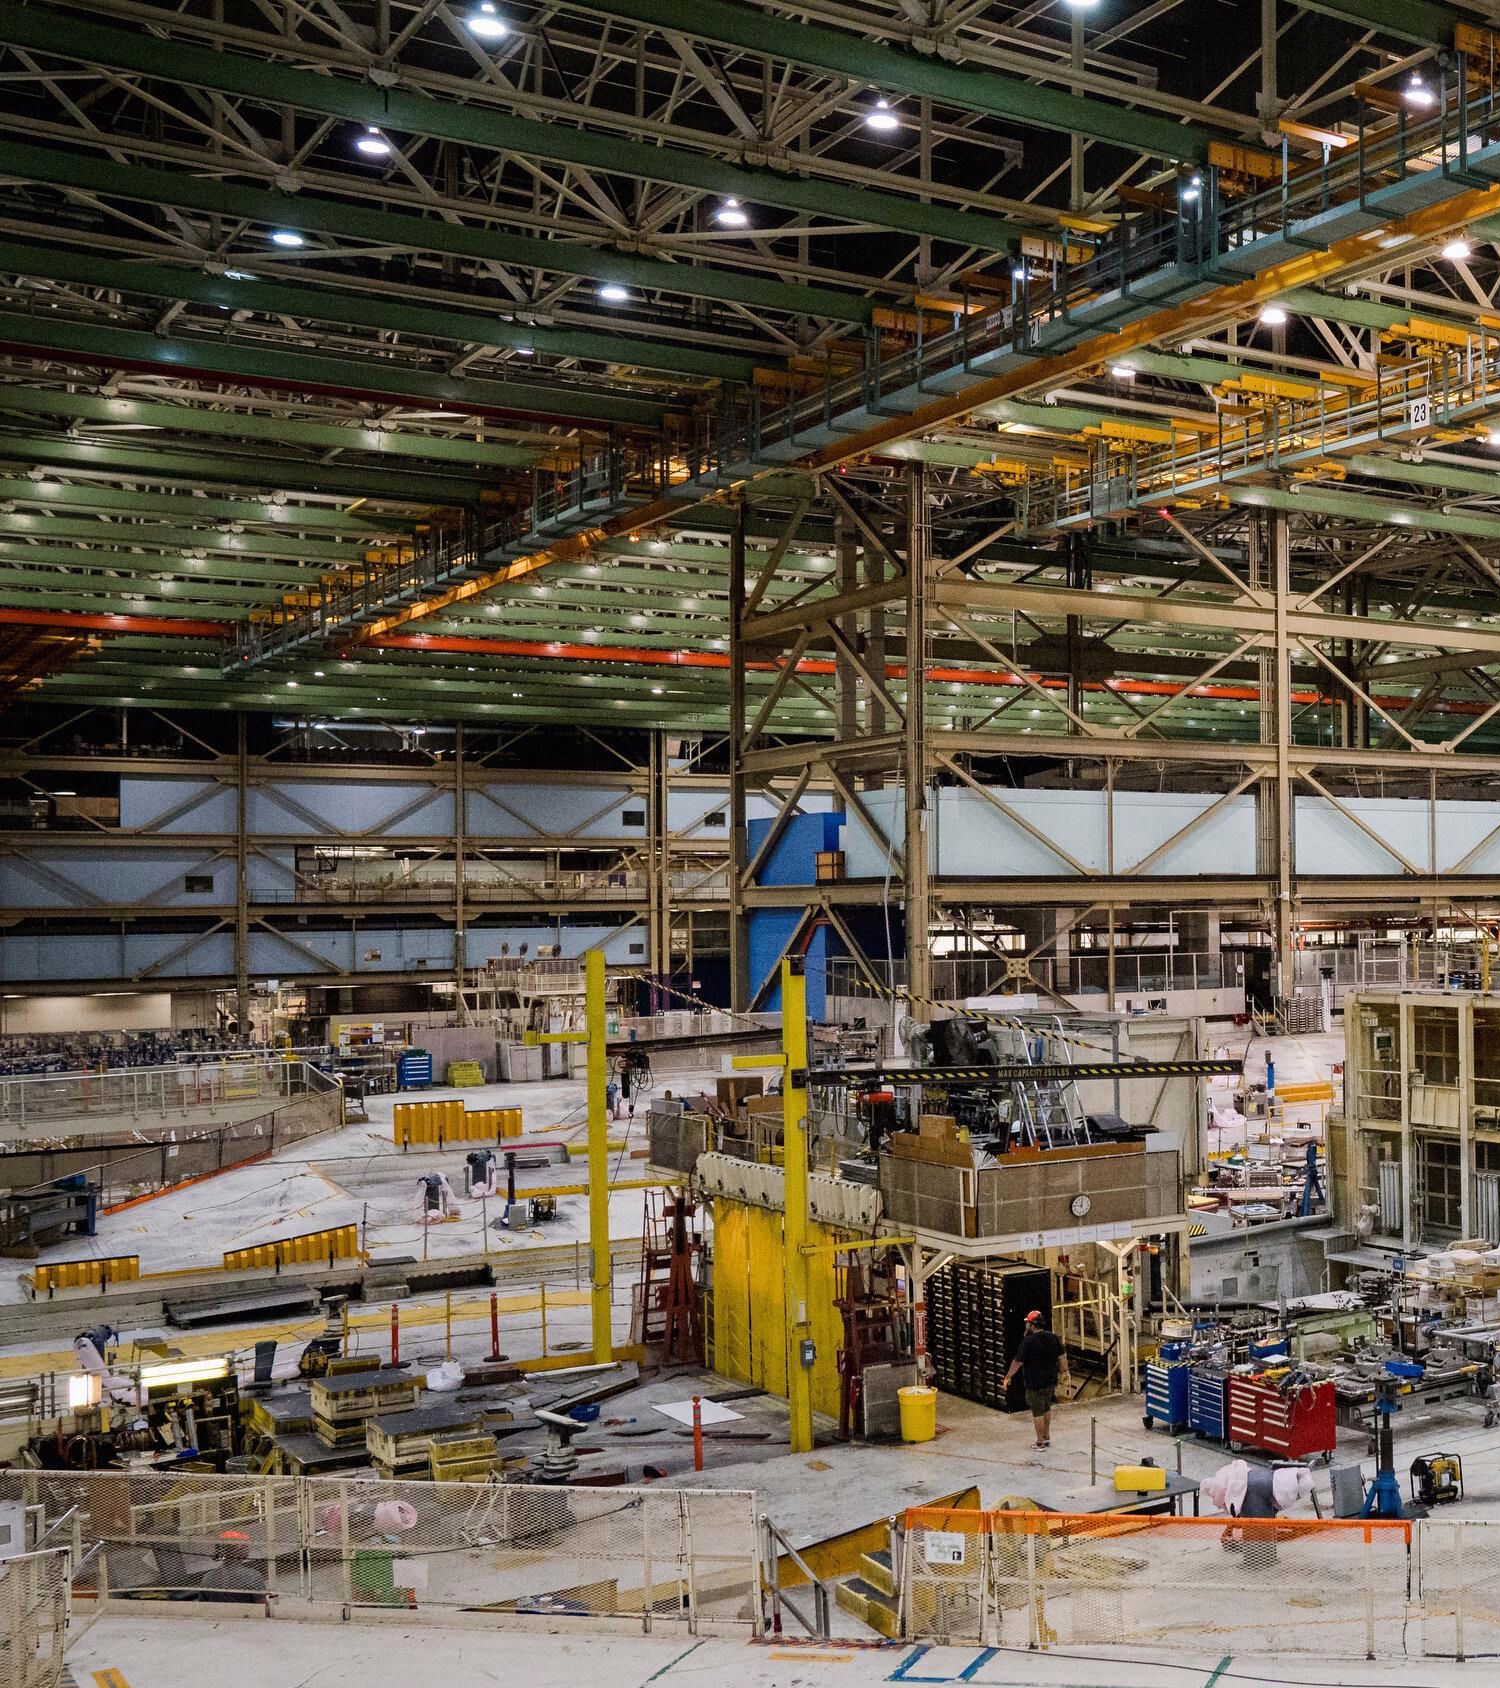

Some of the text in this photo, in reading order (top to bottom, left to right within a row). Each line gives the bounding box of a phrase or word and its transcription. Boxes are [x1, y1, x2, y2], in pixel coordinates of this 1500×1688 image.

[1413, 403, 1426, 423] 23
[997, 1067, 1070, 1078] MAX CAPACITY 250 LBS
